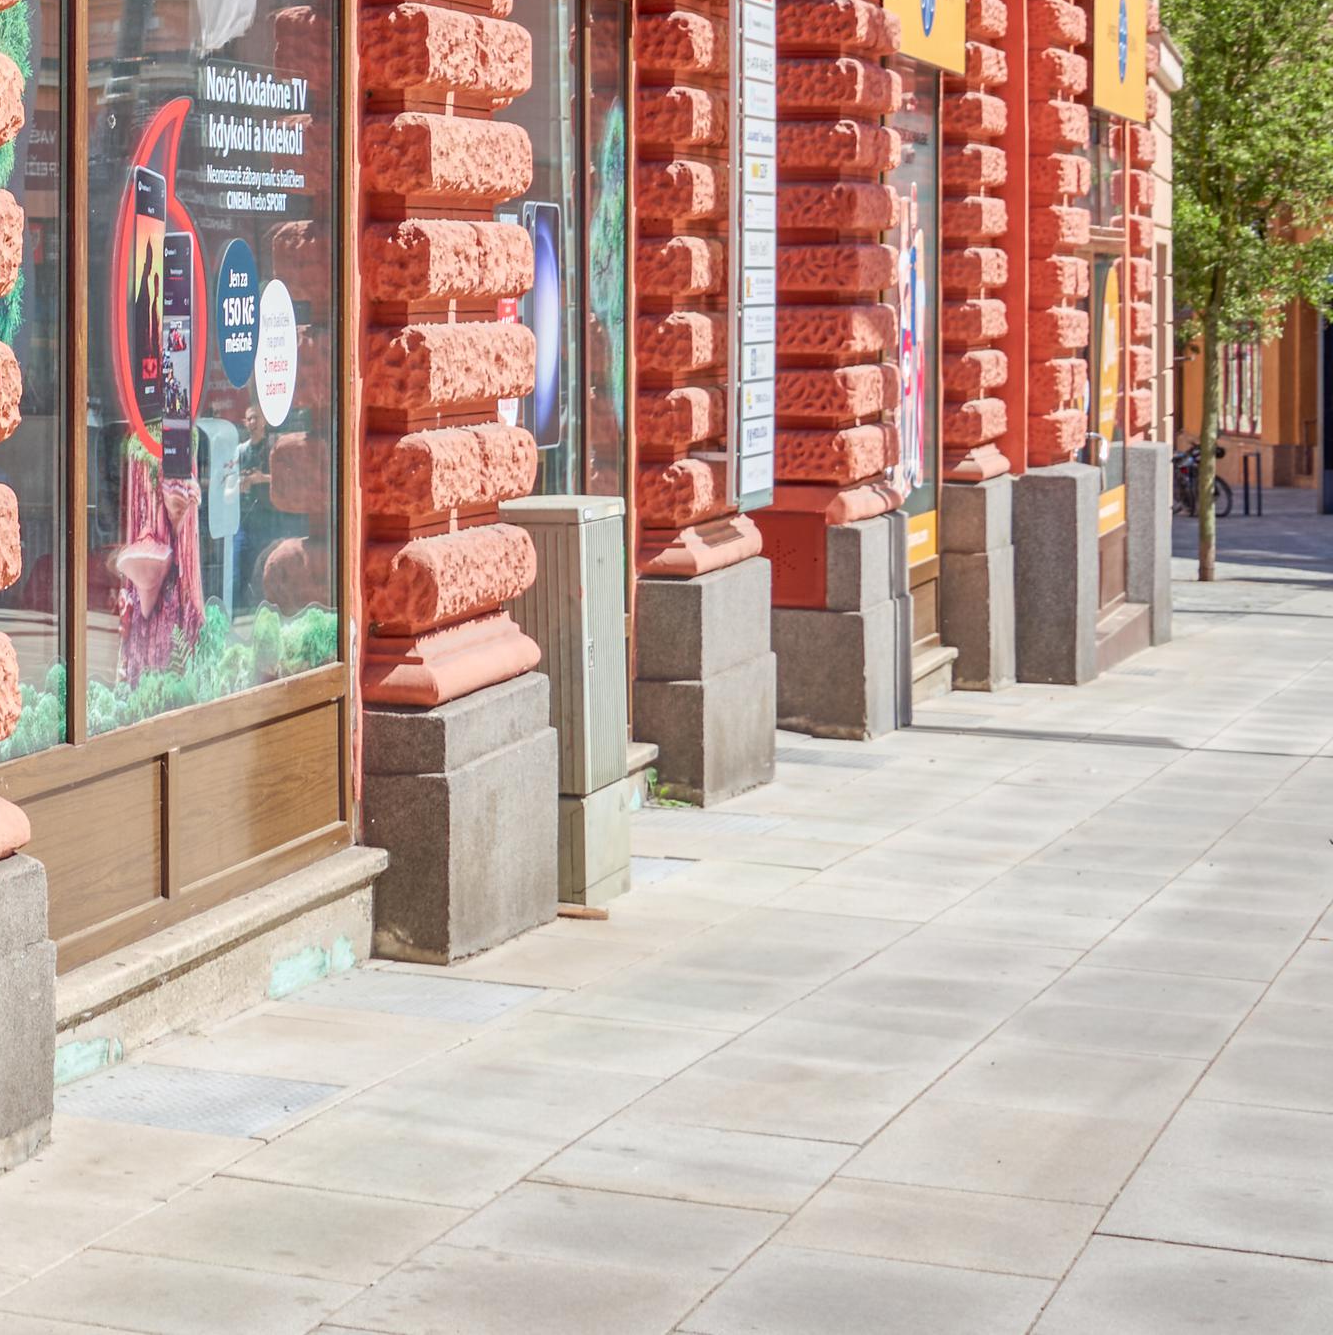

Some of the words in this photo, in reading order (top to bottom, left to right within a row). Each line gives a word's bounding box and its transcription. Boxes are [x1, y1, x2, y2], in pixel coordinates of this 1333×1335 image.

[206, 66, 237, 103] Nová
[238, 70, 291, 109] Vodafone
[292, 78, 308, 111] TV
[209, 113, 252, 157] kdykoli
[253, 126, 261, 152] a
[262, 119, 303, 155] kdekoli
[226, 191, 251, 210] CINEMA
[266, 192, 287, 211] SPORT
[229, 269, 240, 288] Jen
[240, 273, 248, 288] za
[223, 298, 242, 327] 150
[242, 295, 255, 326] Kč
